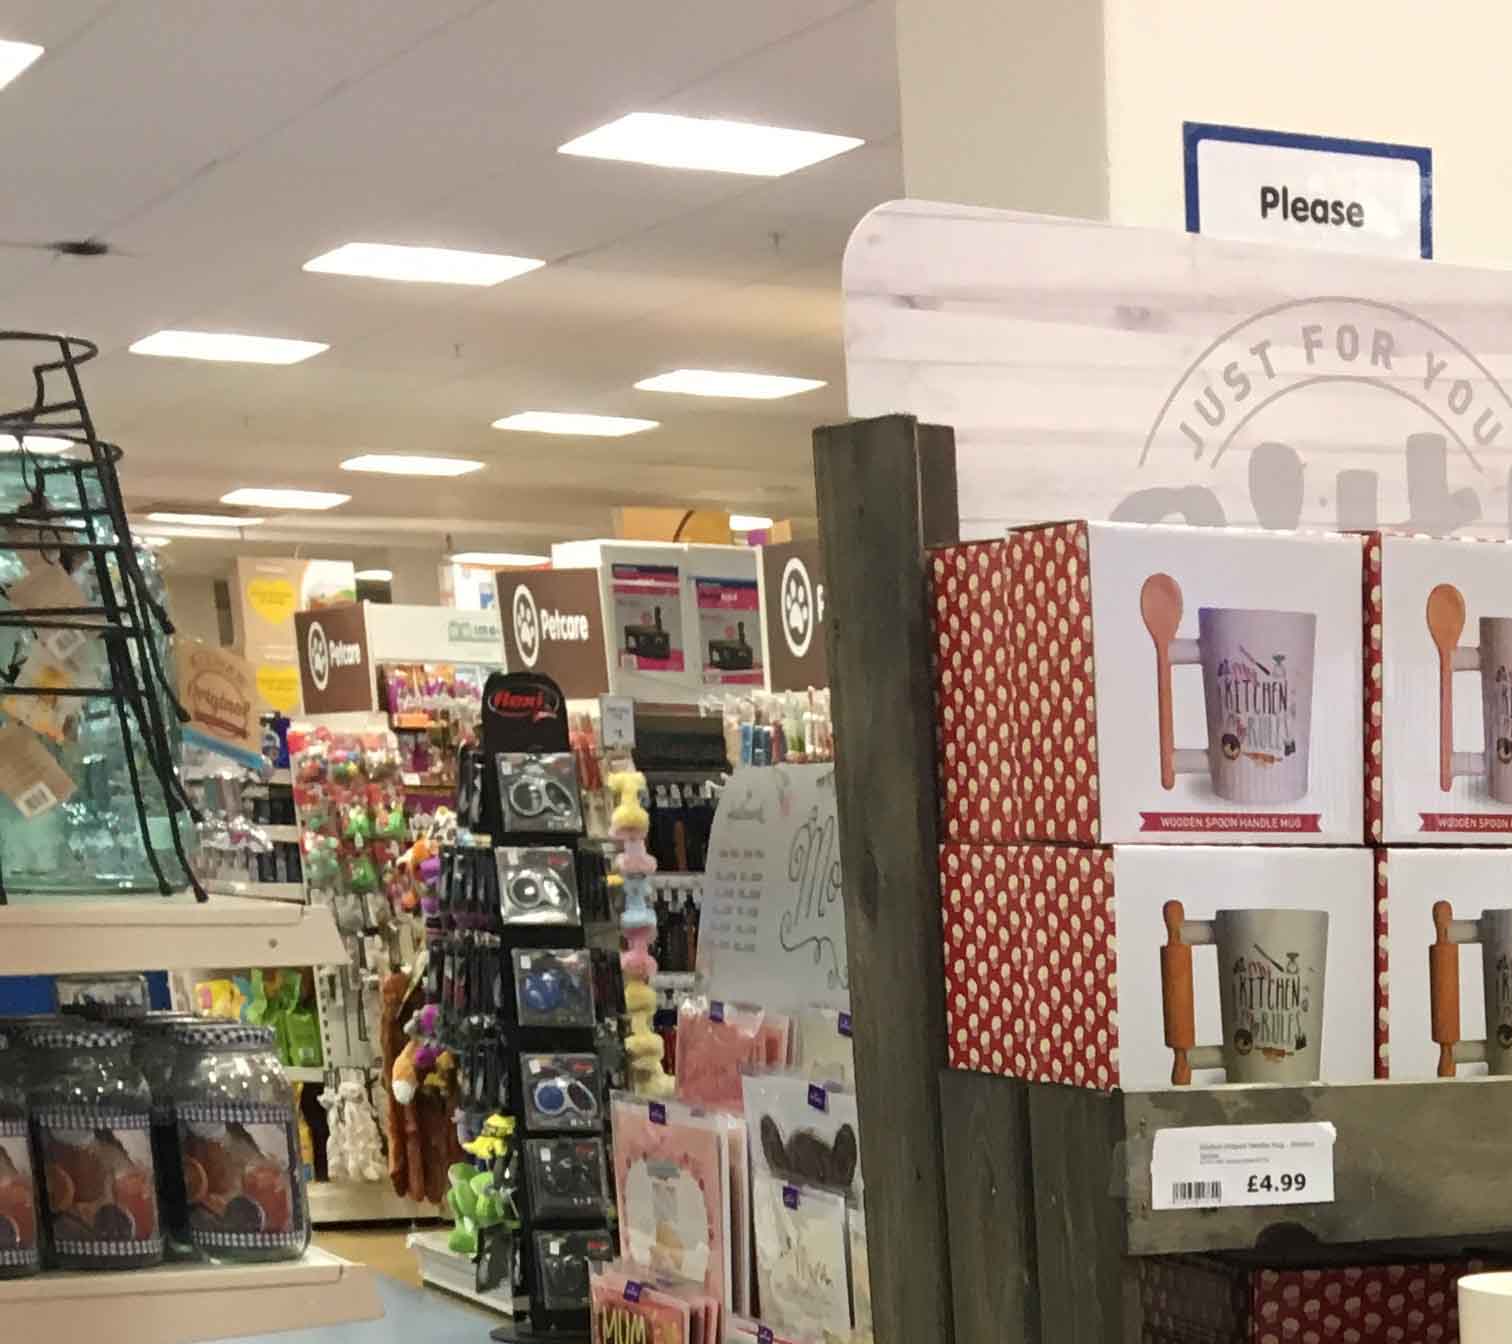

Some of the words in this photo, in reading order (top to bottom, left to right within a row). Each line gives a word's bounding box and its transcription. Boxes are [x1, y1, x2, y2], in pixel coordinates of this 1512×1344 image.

[1259, 185, 1365, 229] Please
[1178, 340, 1278, 461] JUST
[1301, 323, 1396, 370] FOR
[1424, 351, 1504, 447] YOU
[539, 608, 589, 641] Petcare
[328, 642, 361, 667] Petcare
[1224, 679, 1289, 713] KITCHEN
[1239, 974, 1301, 1012] KITCHEN
[1246, 1172, 1308, 1194] £4.99
